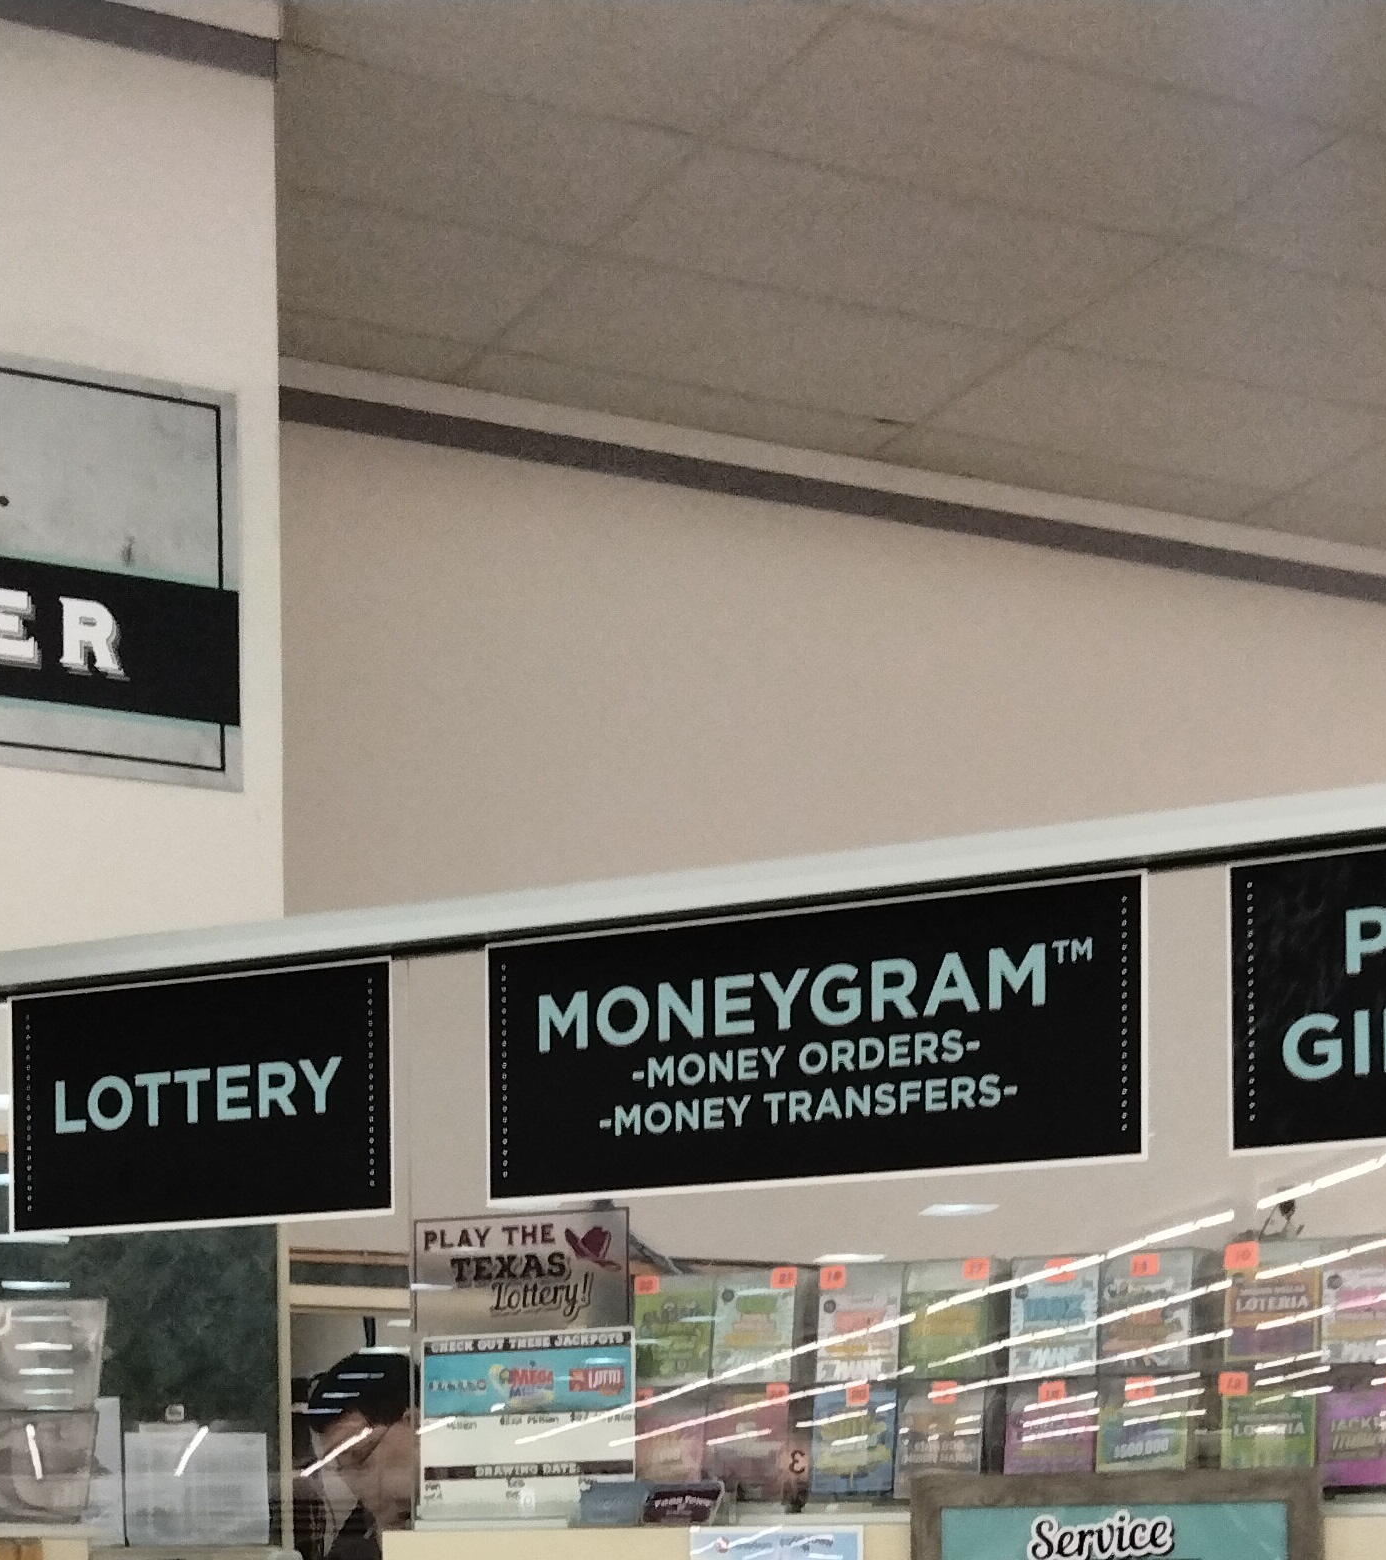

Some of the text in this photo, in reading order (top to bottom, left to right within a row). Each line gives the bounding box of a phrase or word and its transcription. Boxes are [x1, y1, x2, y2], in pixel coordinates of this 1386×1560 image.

[55, 1057, 342, 1134] LOTTERY
[423, 1223, 556, 1251] PLAY THE
[450, 1252, 570, 1283] TEXAS
[492, 1272, 593, 1322] Lottery!
[1032, 1514, 1174, 1559] Service
